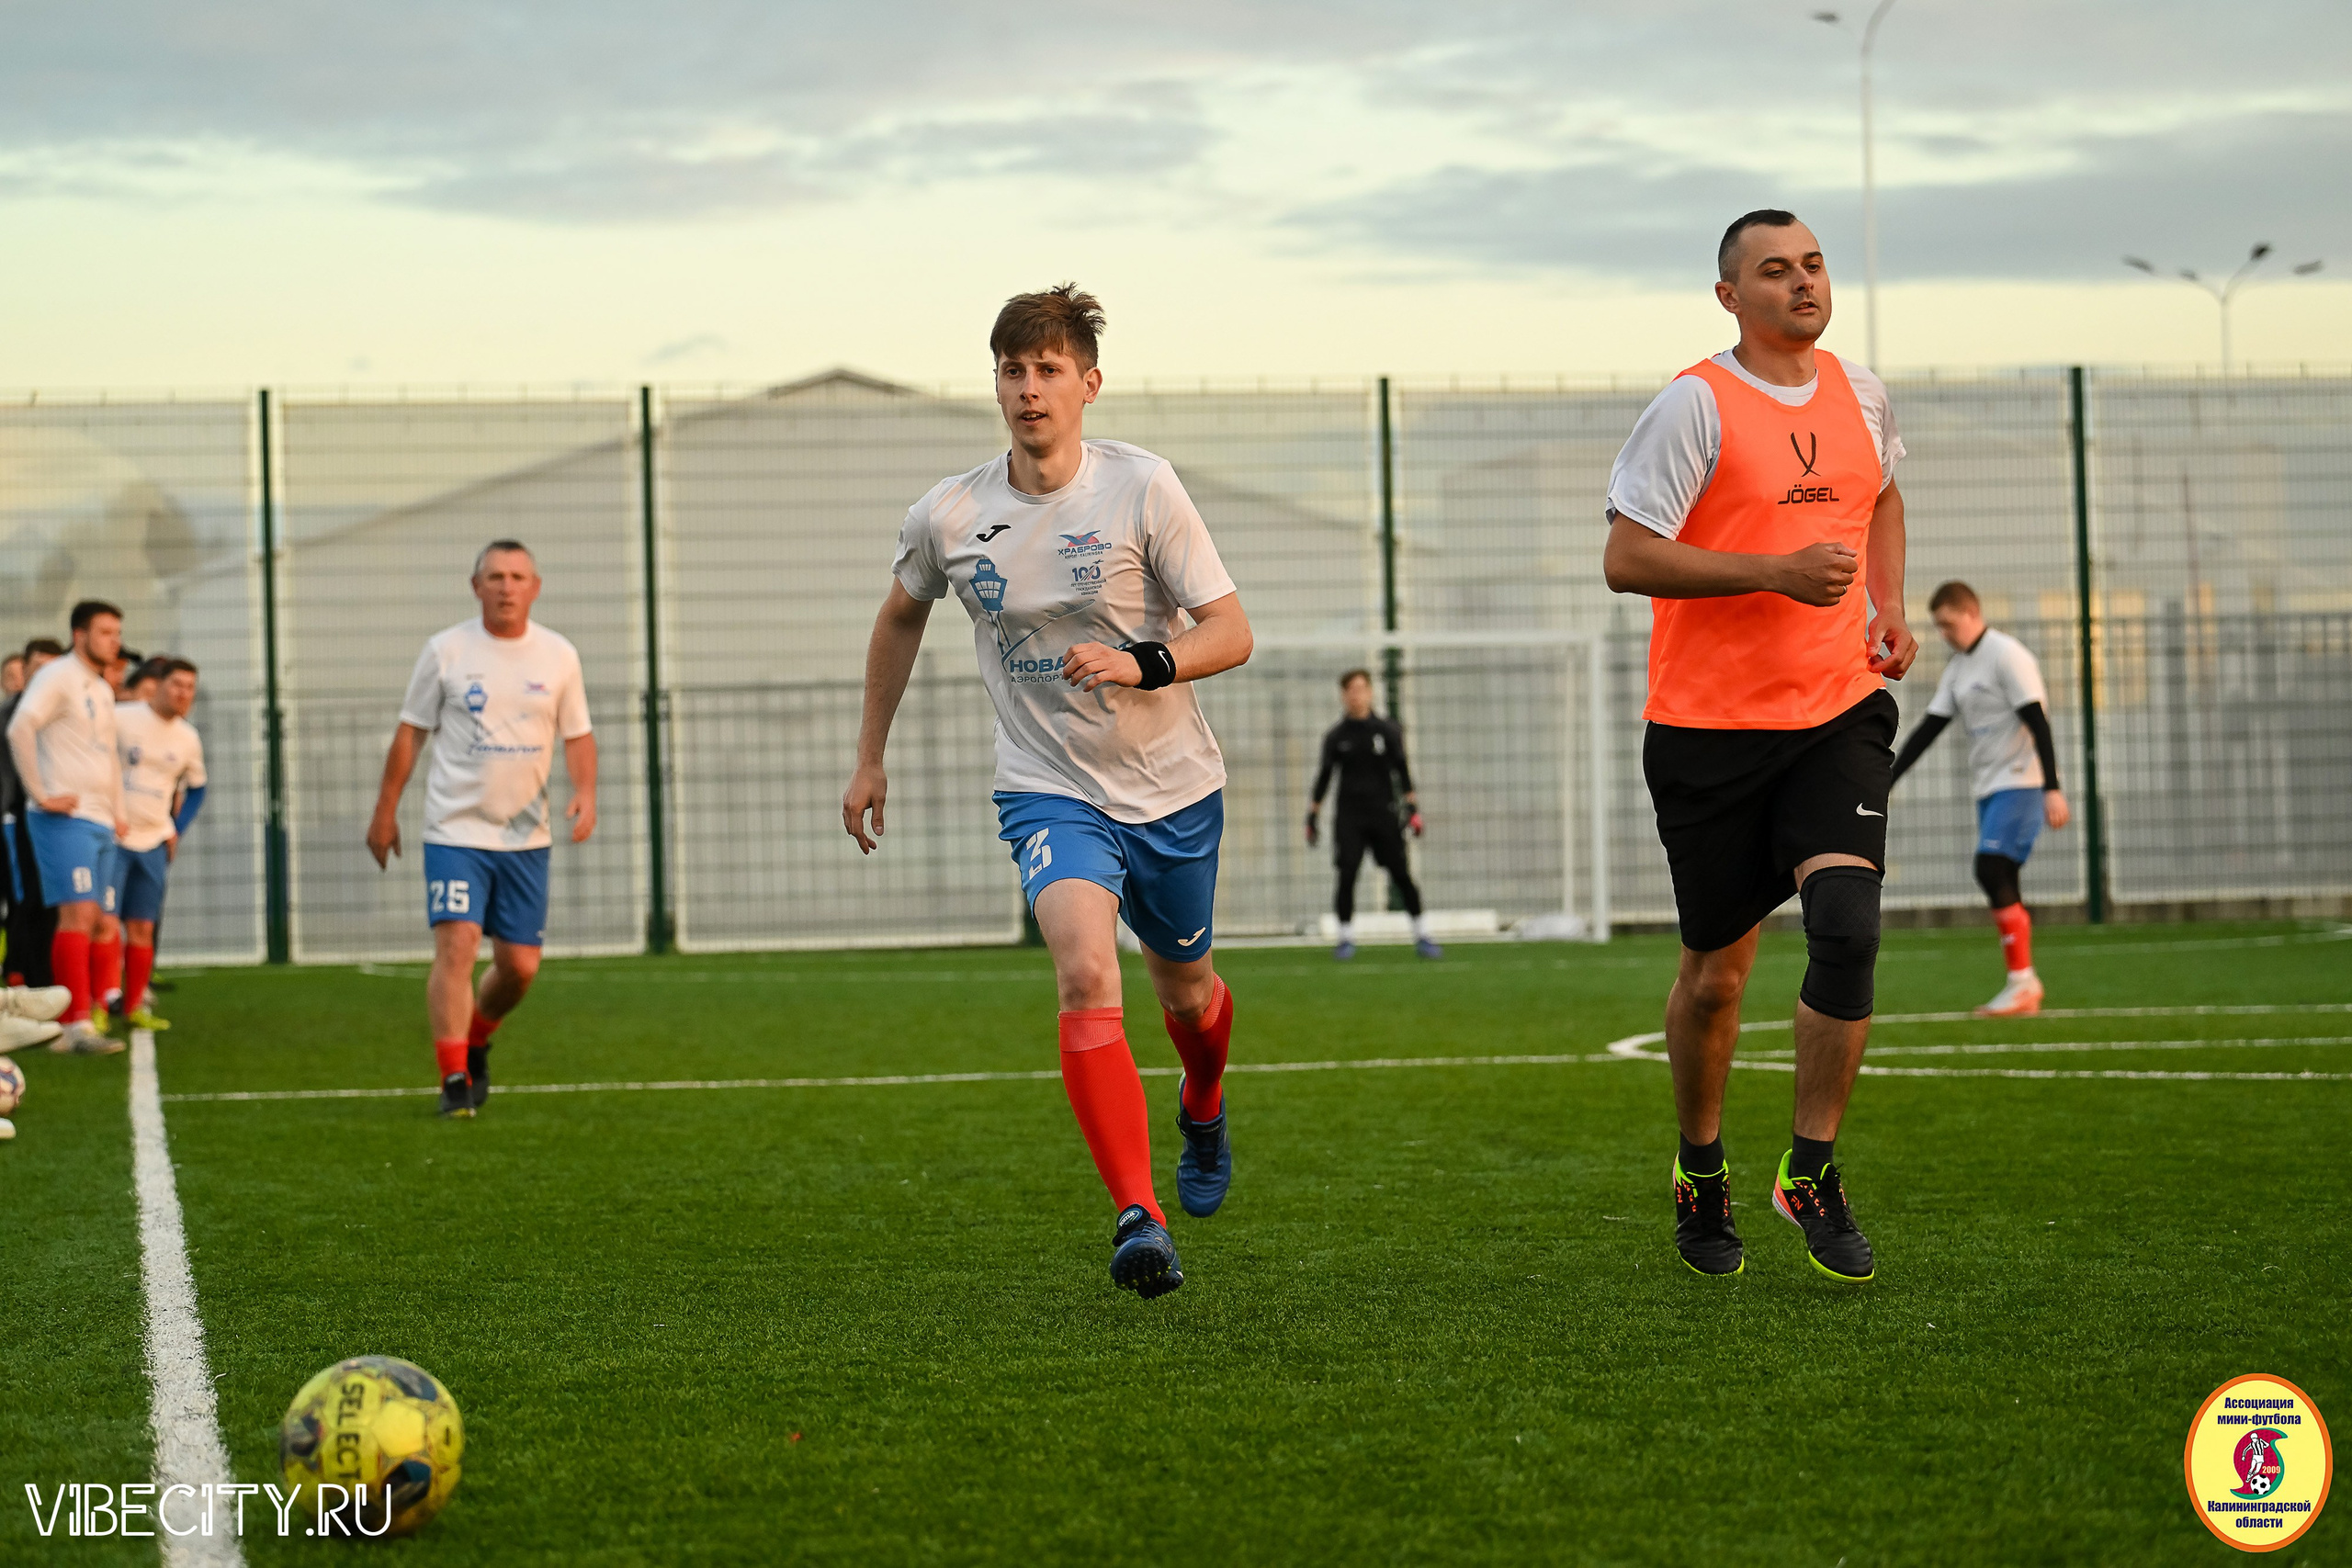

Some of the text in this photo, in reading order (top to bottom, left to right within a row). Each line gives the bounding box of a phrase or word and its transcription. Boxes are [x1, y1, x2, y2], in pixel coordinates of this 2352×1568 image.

[1777, 484, 1839, 504] JÖGEL
[1057, 542, 1113, 556] ХРАБРОВО
[1071, 564, 1102, 581] 100
[1010, 656, 1065, 673] НОВА
[1011, 673, 1065, 683] АЭРОПОРТ
[1026, 828, 1052, 880] 3
[430, 880, 469, 913] 25
[336, 1383, 365, 1480] SELECT
